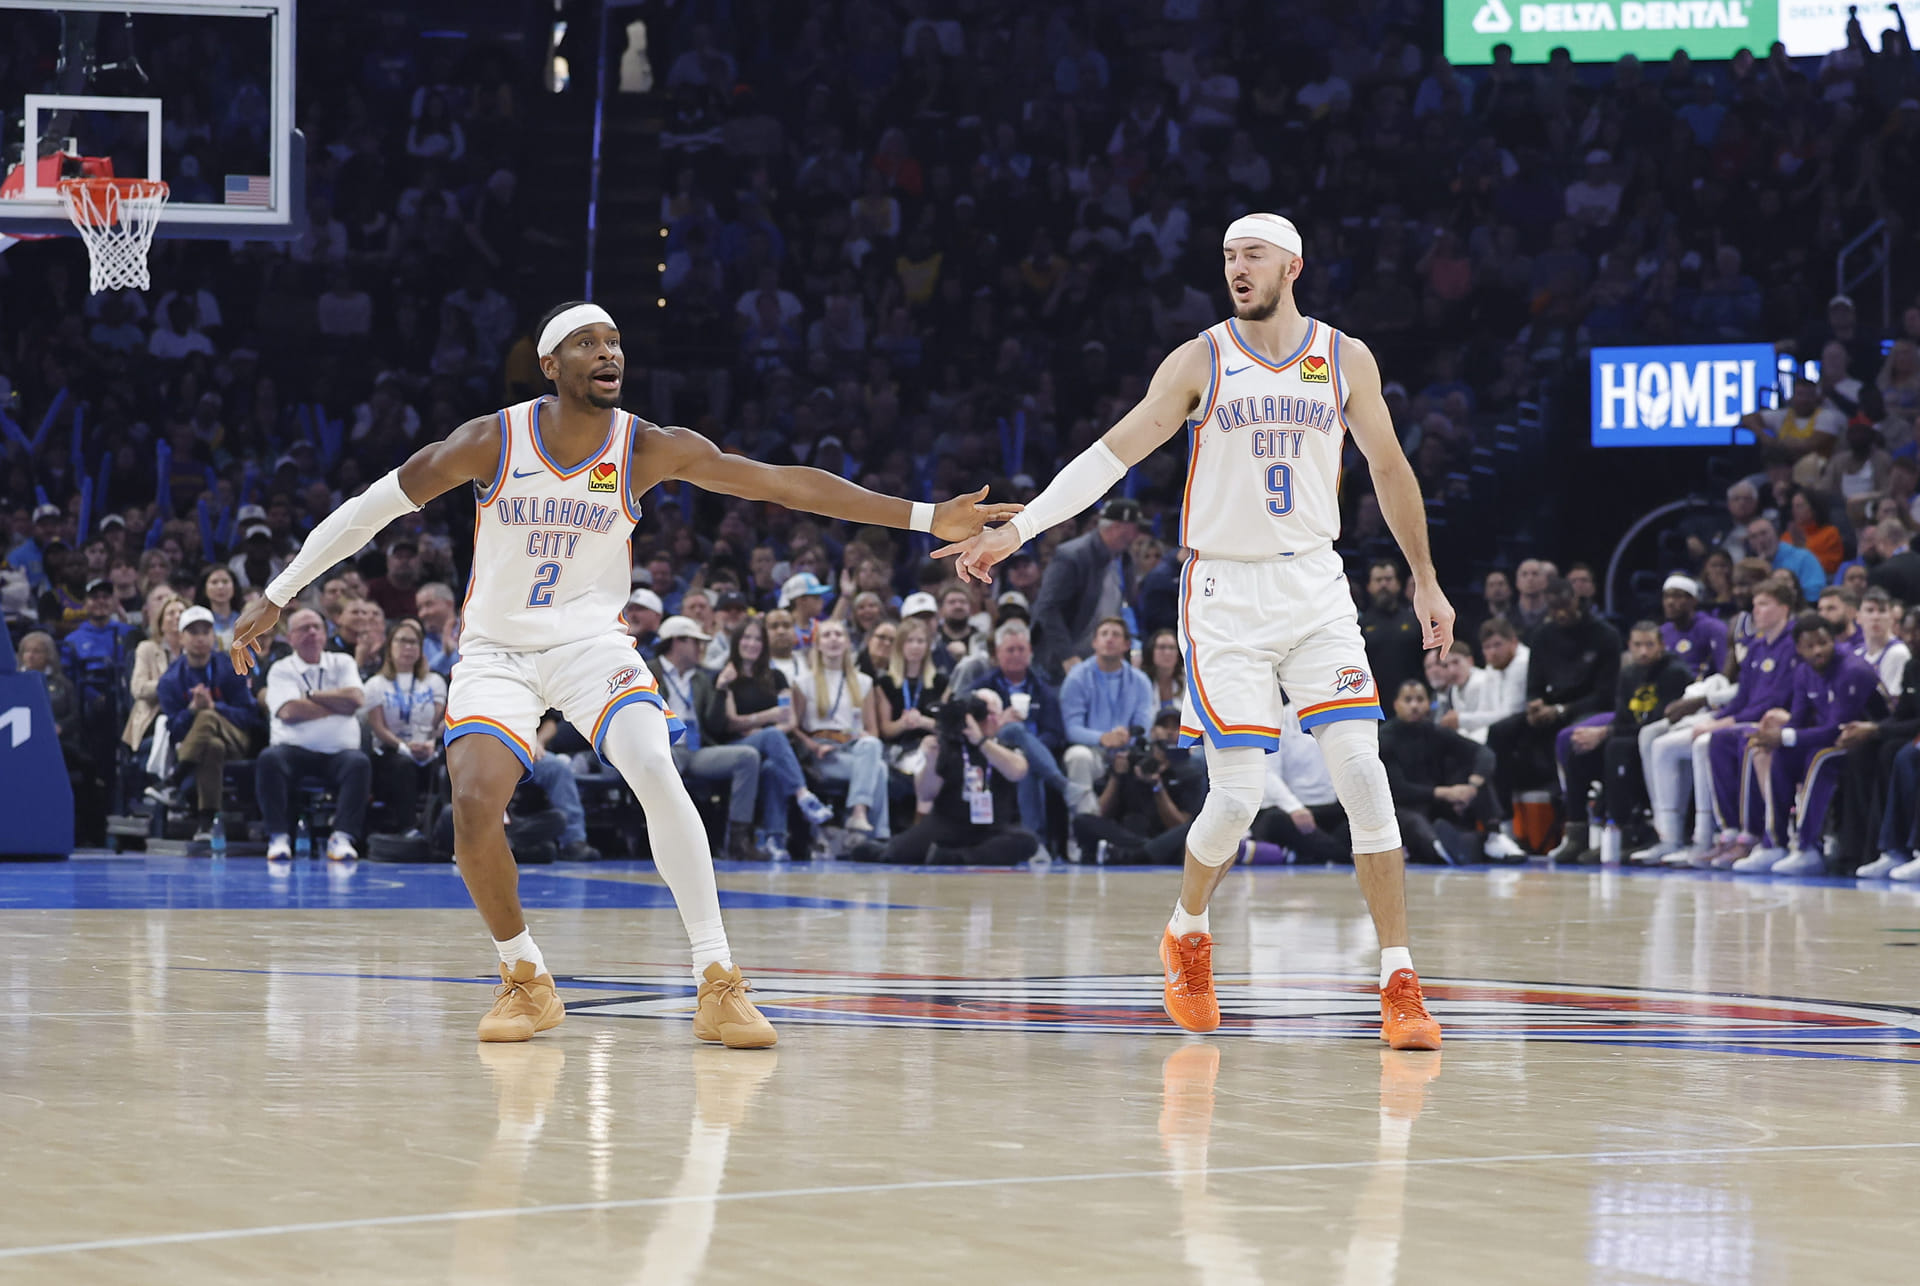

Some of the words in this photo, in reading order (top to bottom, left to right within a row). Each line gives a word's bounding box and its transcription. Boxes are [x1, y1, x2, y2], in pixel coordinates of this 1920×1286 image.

[1520, 3, 1617, 32] DELTA
[1621, 0, 1749, 29] DENTAL
[1214, 395, 1336, 435] OKLAHOMA
[1252, 430, 1305, 458] CITY
[1264, 462, 1295, 517] 9
[496, 497, 620, 534] OKLAHOMA
[526, 530, 581, 559] CITY
[526, 561, 563, 608] 2
